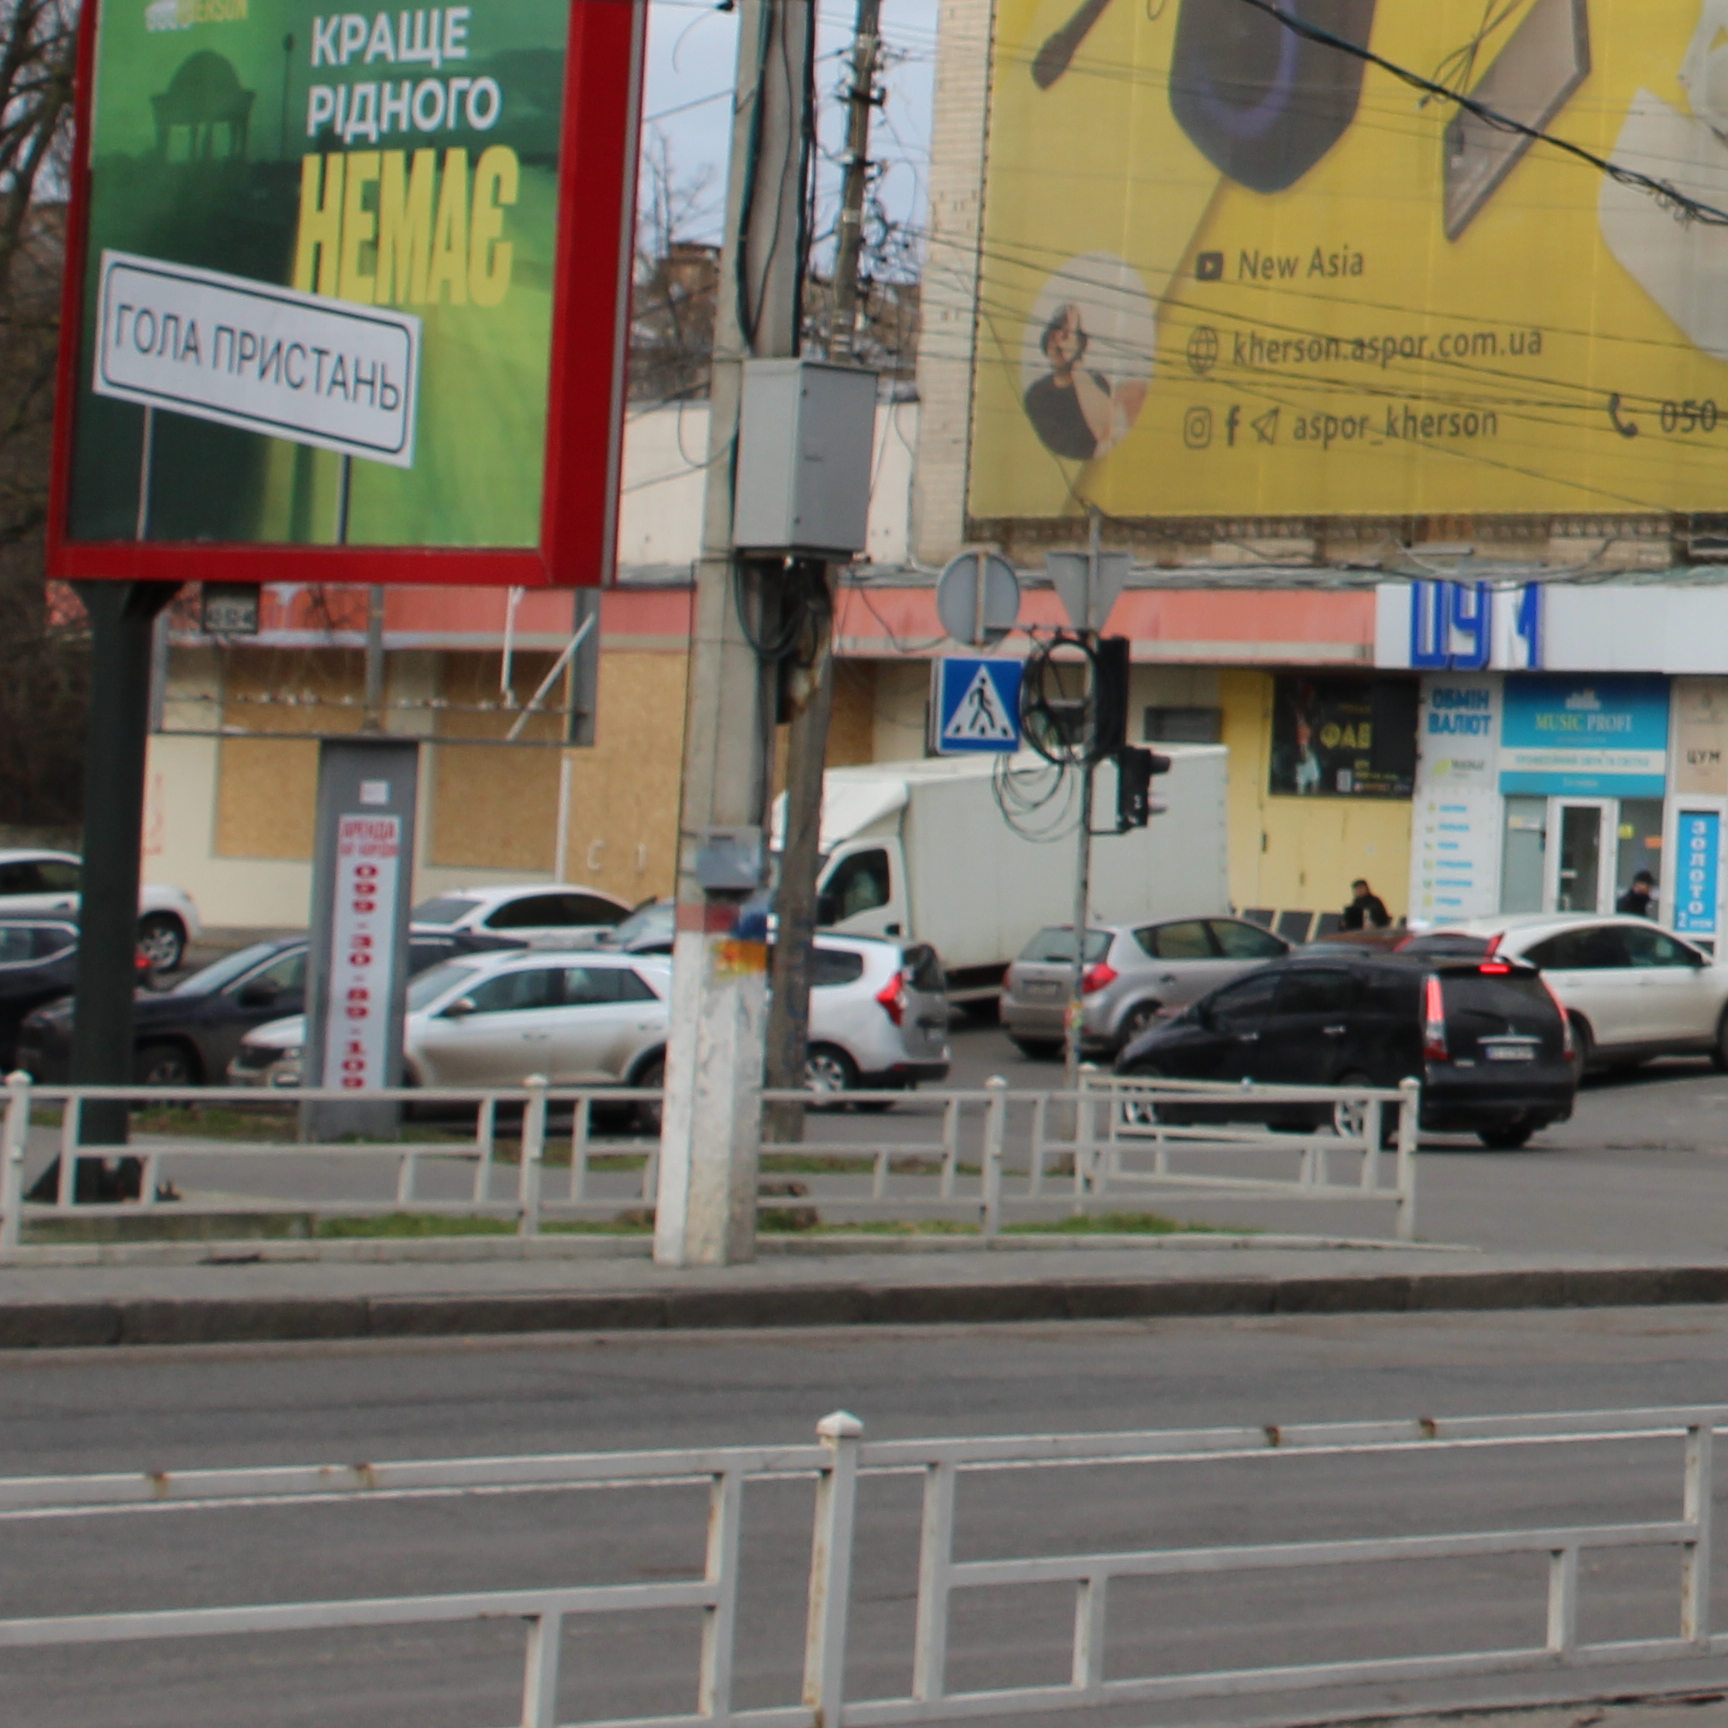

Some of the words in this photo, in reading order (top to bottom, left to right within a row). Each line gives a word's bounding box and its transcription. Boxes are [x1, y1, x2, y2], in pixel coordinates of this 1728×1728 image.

[310, 6, 471, 69] КРАЩЕ
[306, 75, 502, 144] РІДНОГО
[293, 144, 520, 308] НЕМАЄ
[1238, 249, 1299, 279] New
[1307, 245, 1364, 278] Asia
[114, 303, 204, 366] ГОЛА
[212, 324, 401, 412] ПРИСТАНЬ
[1232, 328, 1544, 369] kherson.aspor.com.ua
[1293, 404, 1498, 450] aspor_kherson
